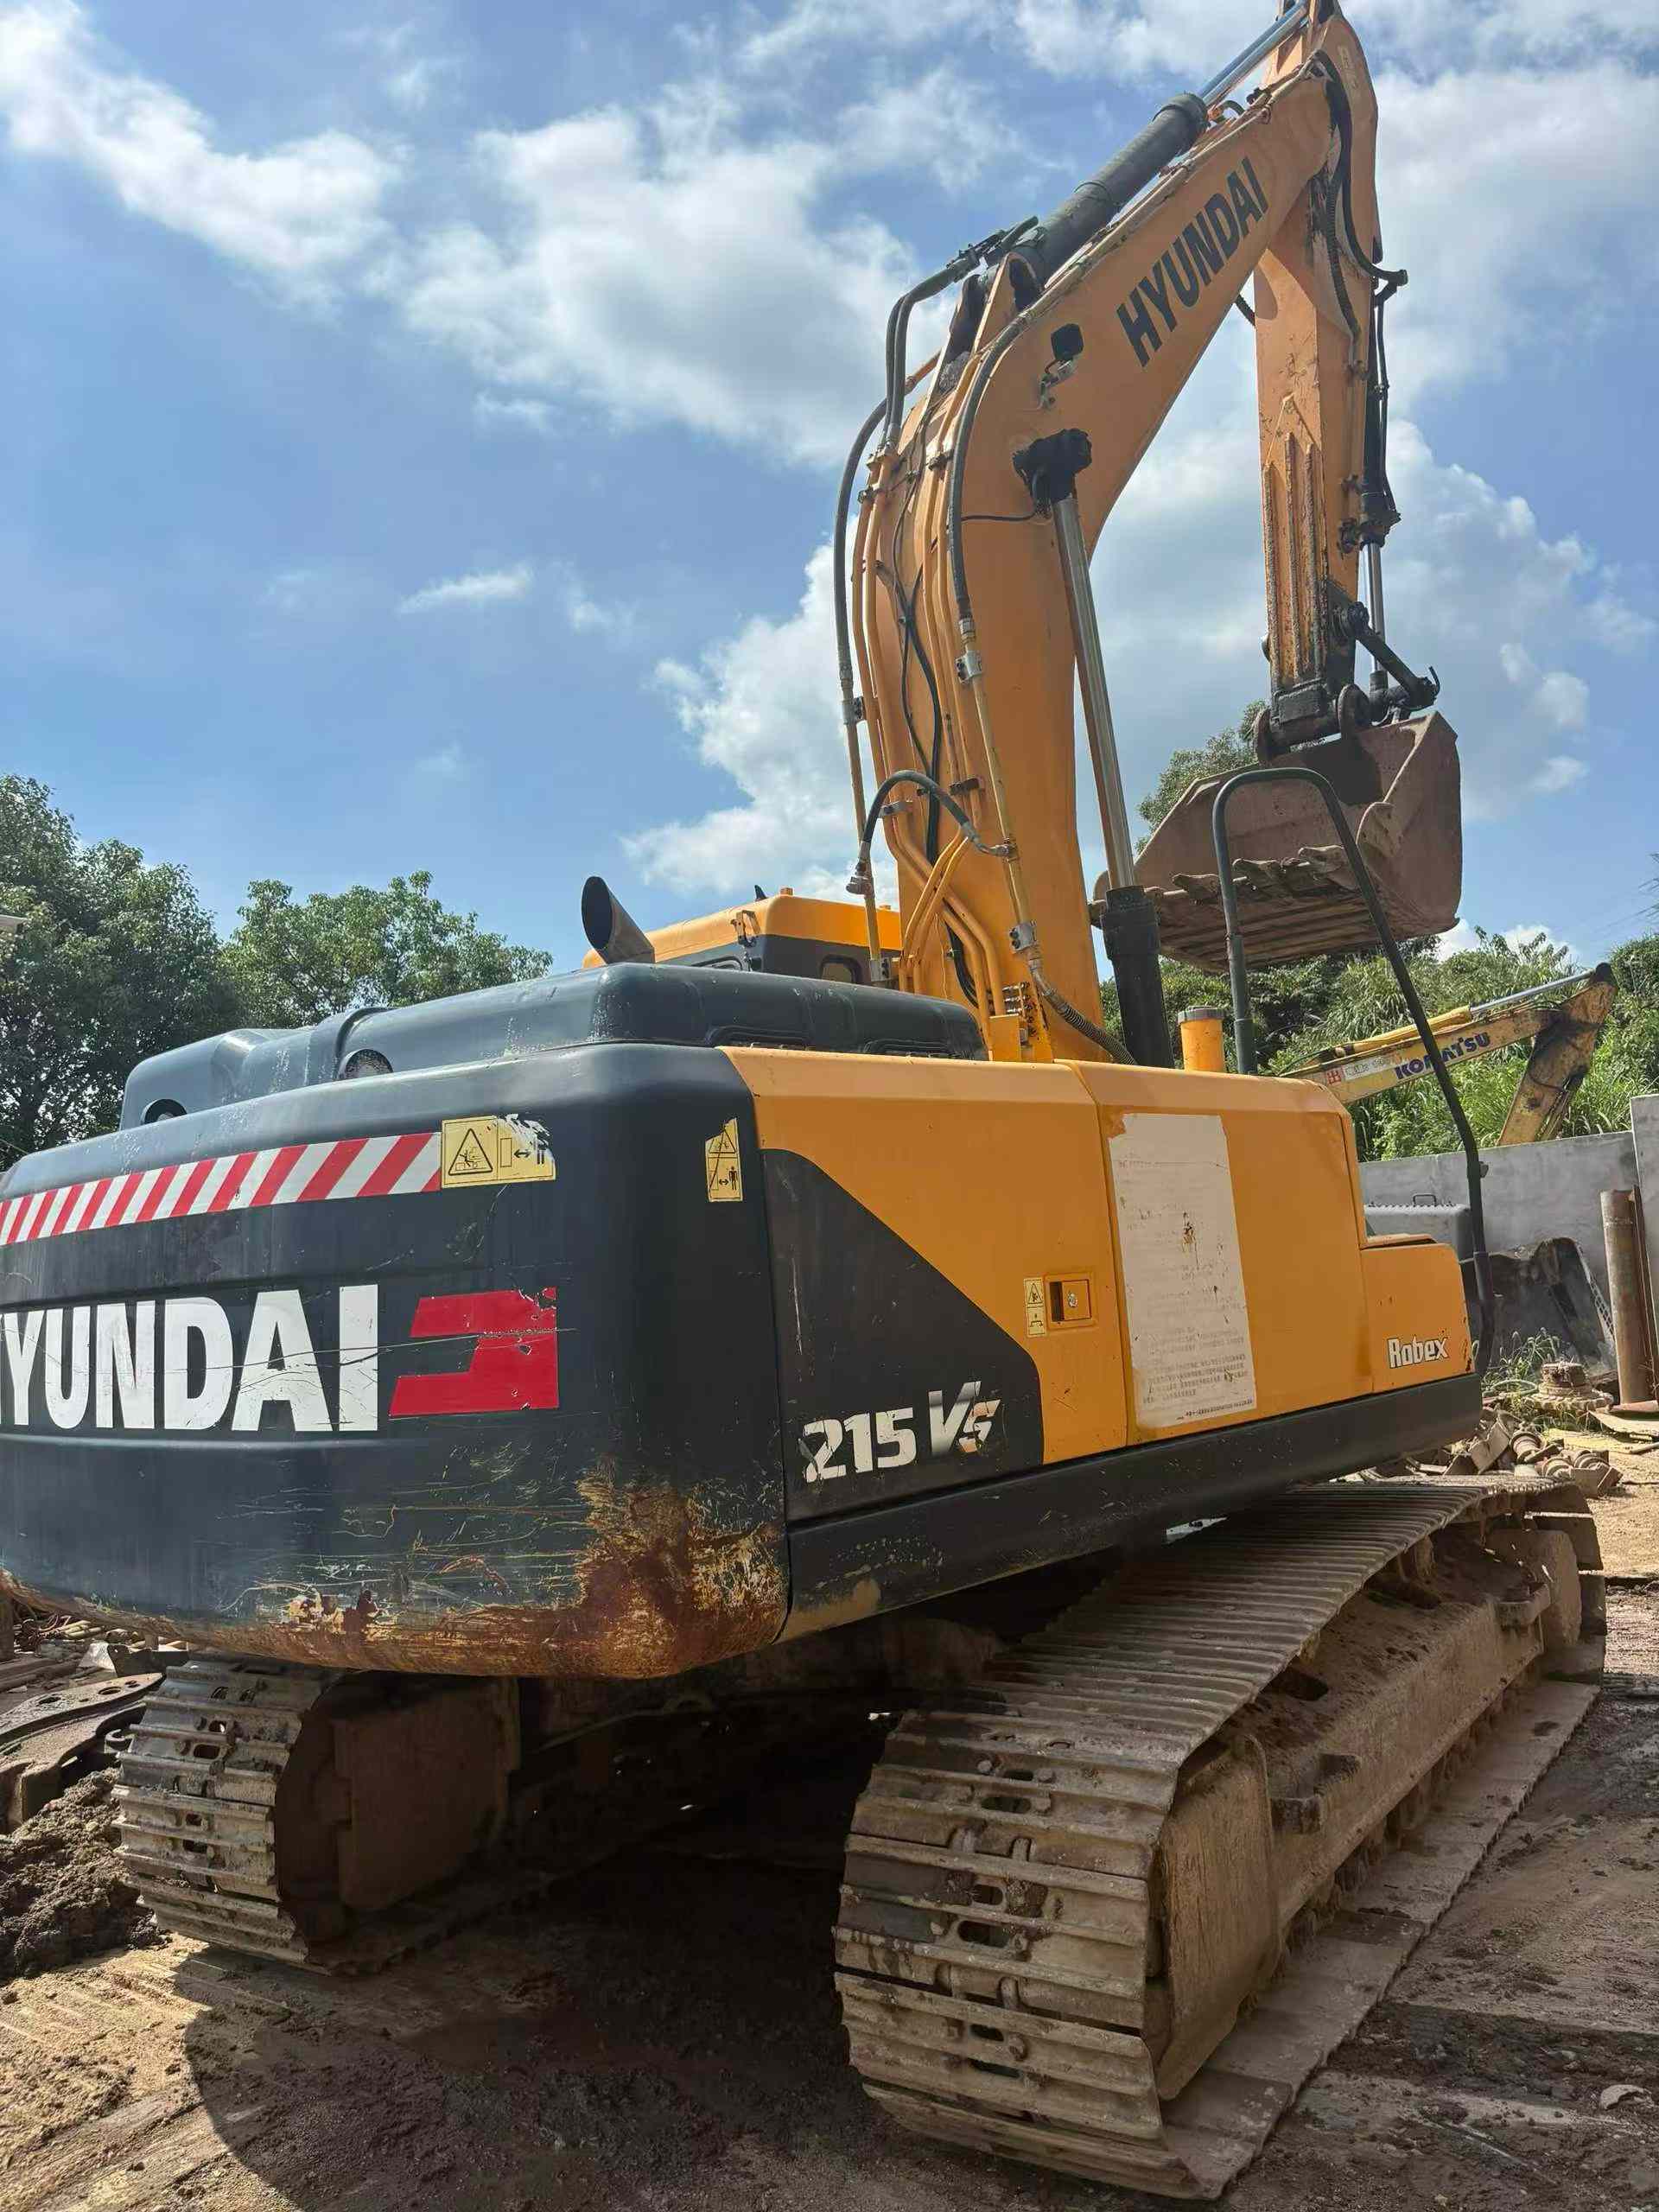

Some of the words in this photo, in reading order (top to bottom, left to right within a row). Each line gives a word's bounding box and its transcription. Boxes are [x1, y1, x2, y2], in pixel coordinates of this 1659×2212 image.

[1116, 156, 1269, 368] HYUNDAI
[0, 1284, 378, 1432] YUNDAI
[1388, 1336, 1448, 1369] Robex
[803, 1407, 917, 1483] 215
